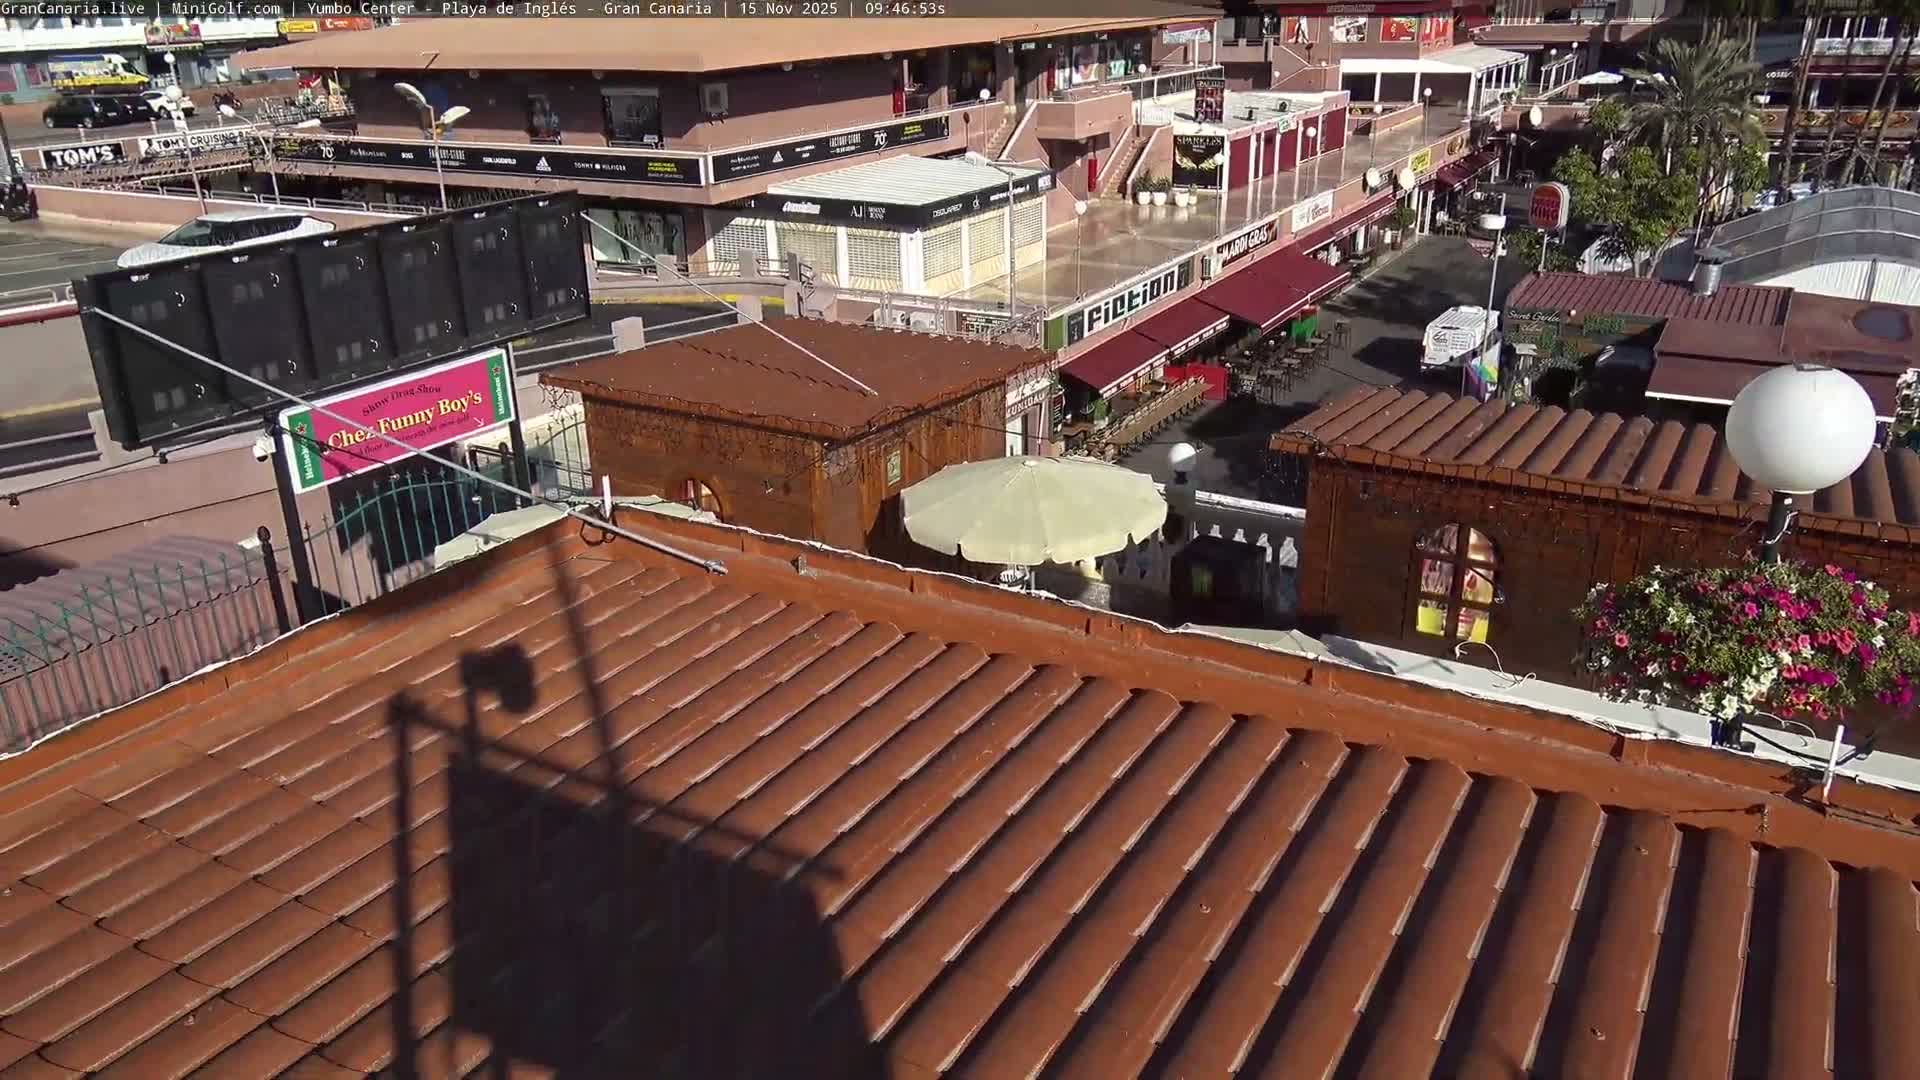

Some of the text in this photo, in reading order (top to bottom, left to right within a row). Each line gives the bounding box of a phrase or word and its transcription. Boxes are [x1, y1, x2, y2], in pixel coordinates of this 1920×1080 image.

[50, 144, 115, 166] TOM'S
[1176, 135, 1222, 146] SPARKLES
[1222, 224, 1268, 260] MARDI GRAS
[362, 383, 442, 417] Show Drag Show
[328, 426, 377, 449] Chez
[377, 407, 435, 434] Funny
[438, 389, 483, 416] Boy's
